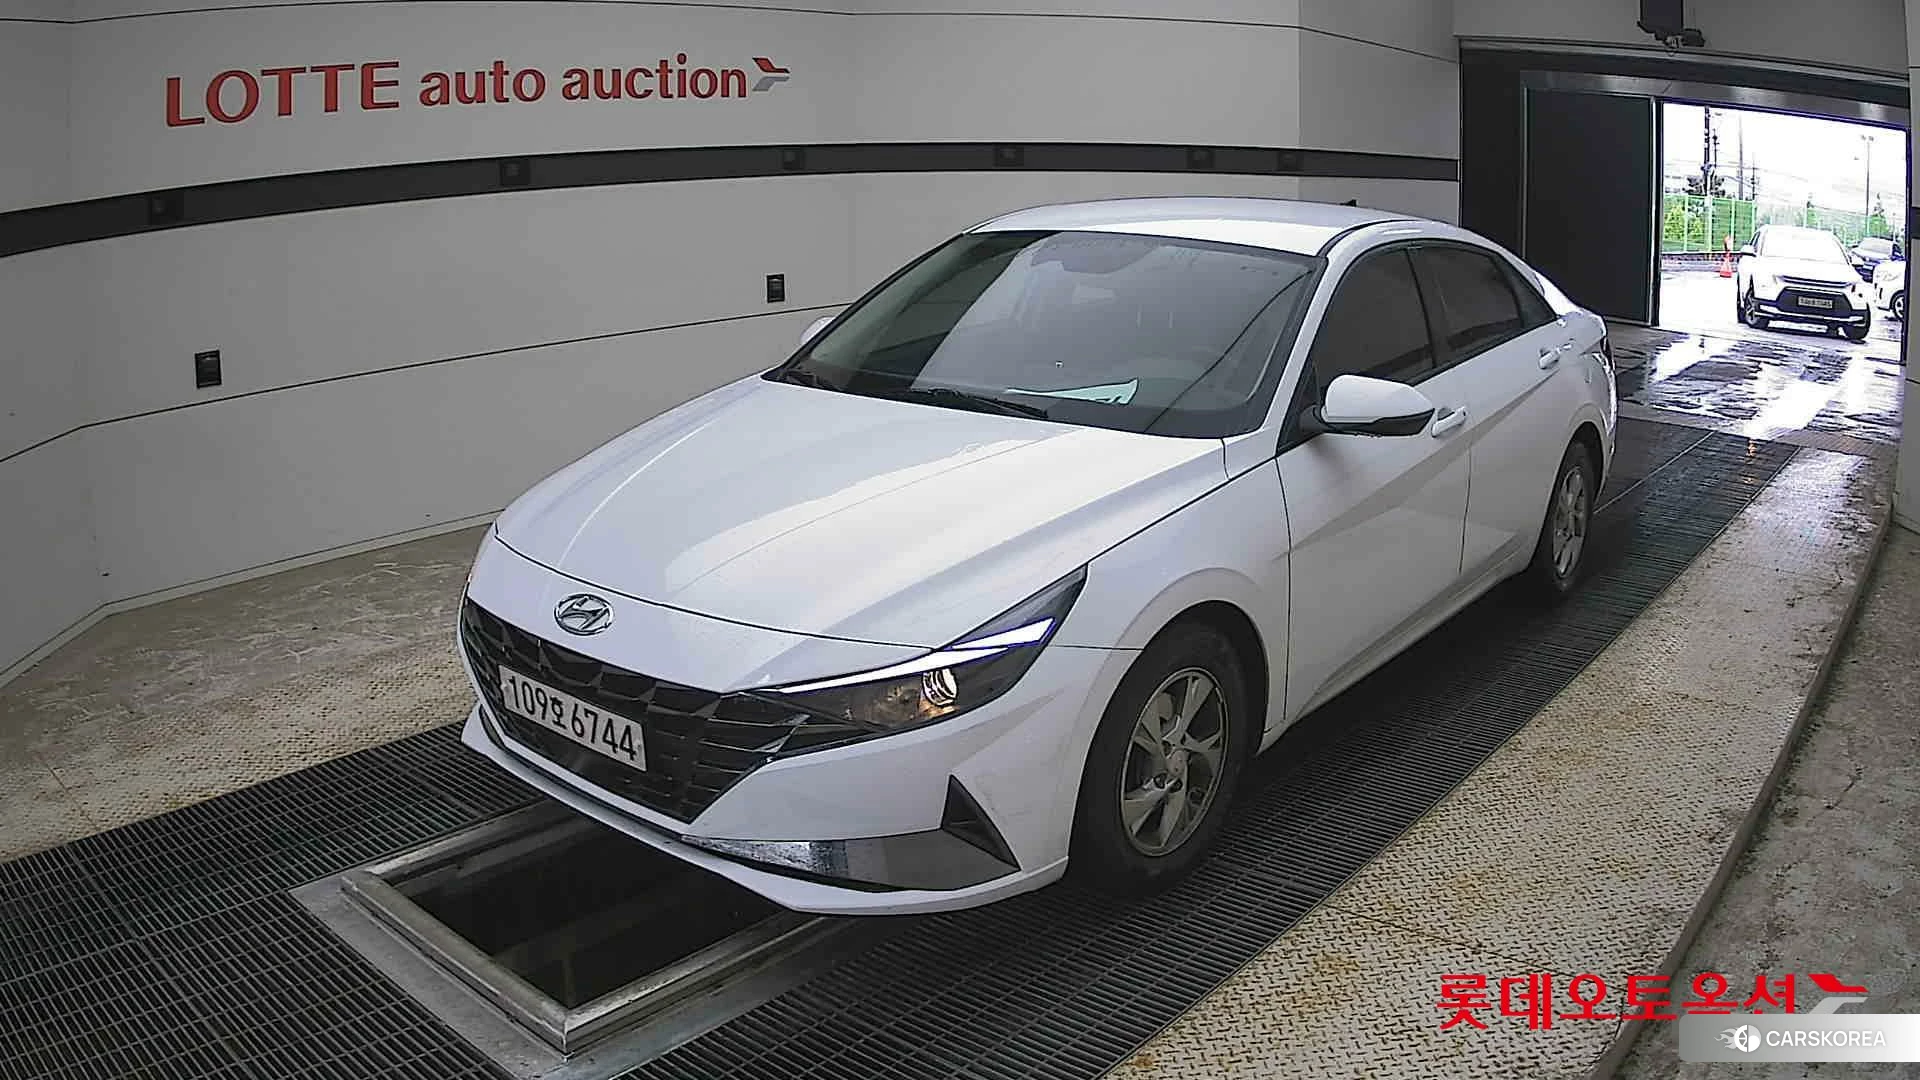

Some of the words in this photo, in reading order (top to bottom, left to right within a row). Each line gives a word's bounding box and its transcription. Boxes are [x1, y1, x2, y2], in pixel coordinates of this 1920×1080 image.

[166, 61, 400, 127] LOTTE
[419, 60, 546, 106] auto
[561, 53, 748, 100] auction
[509, 675, 637, 761] 109호6744
